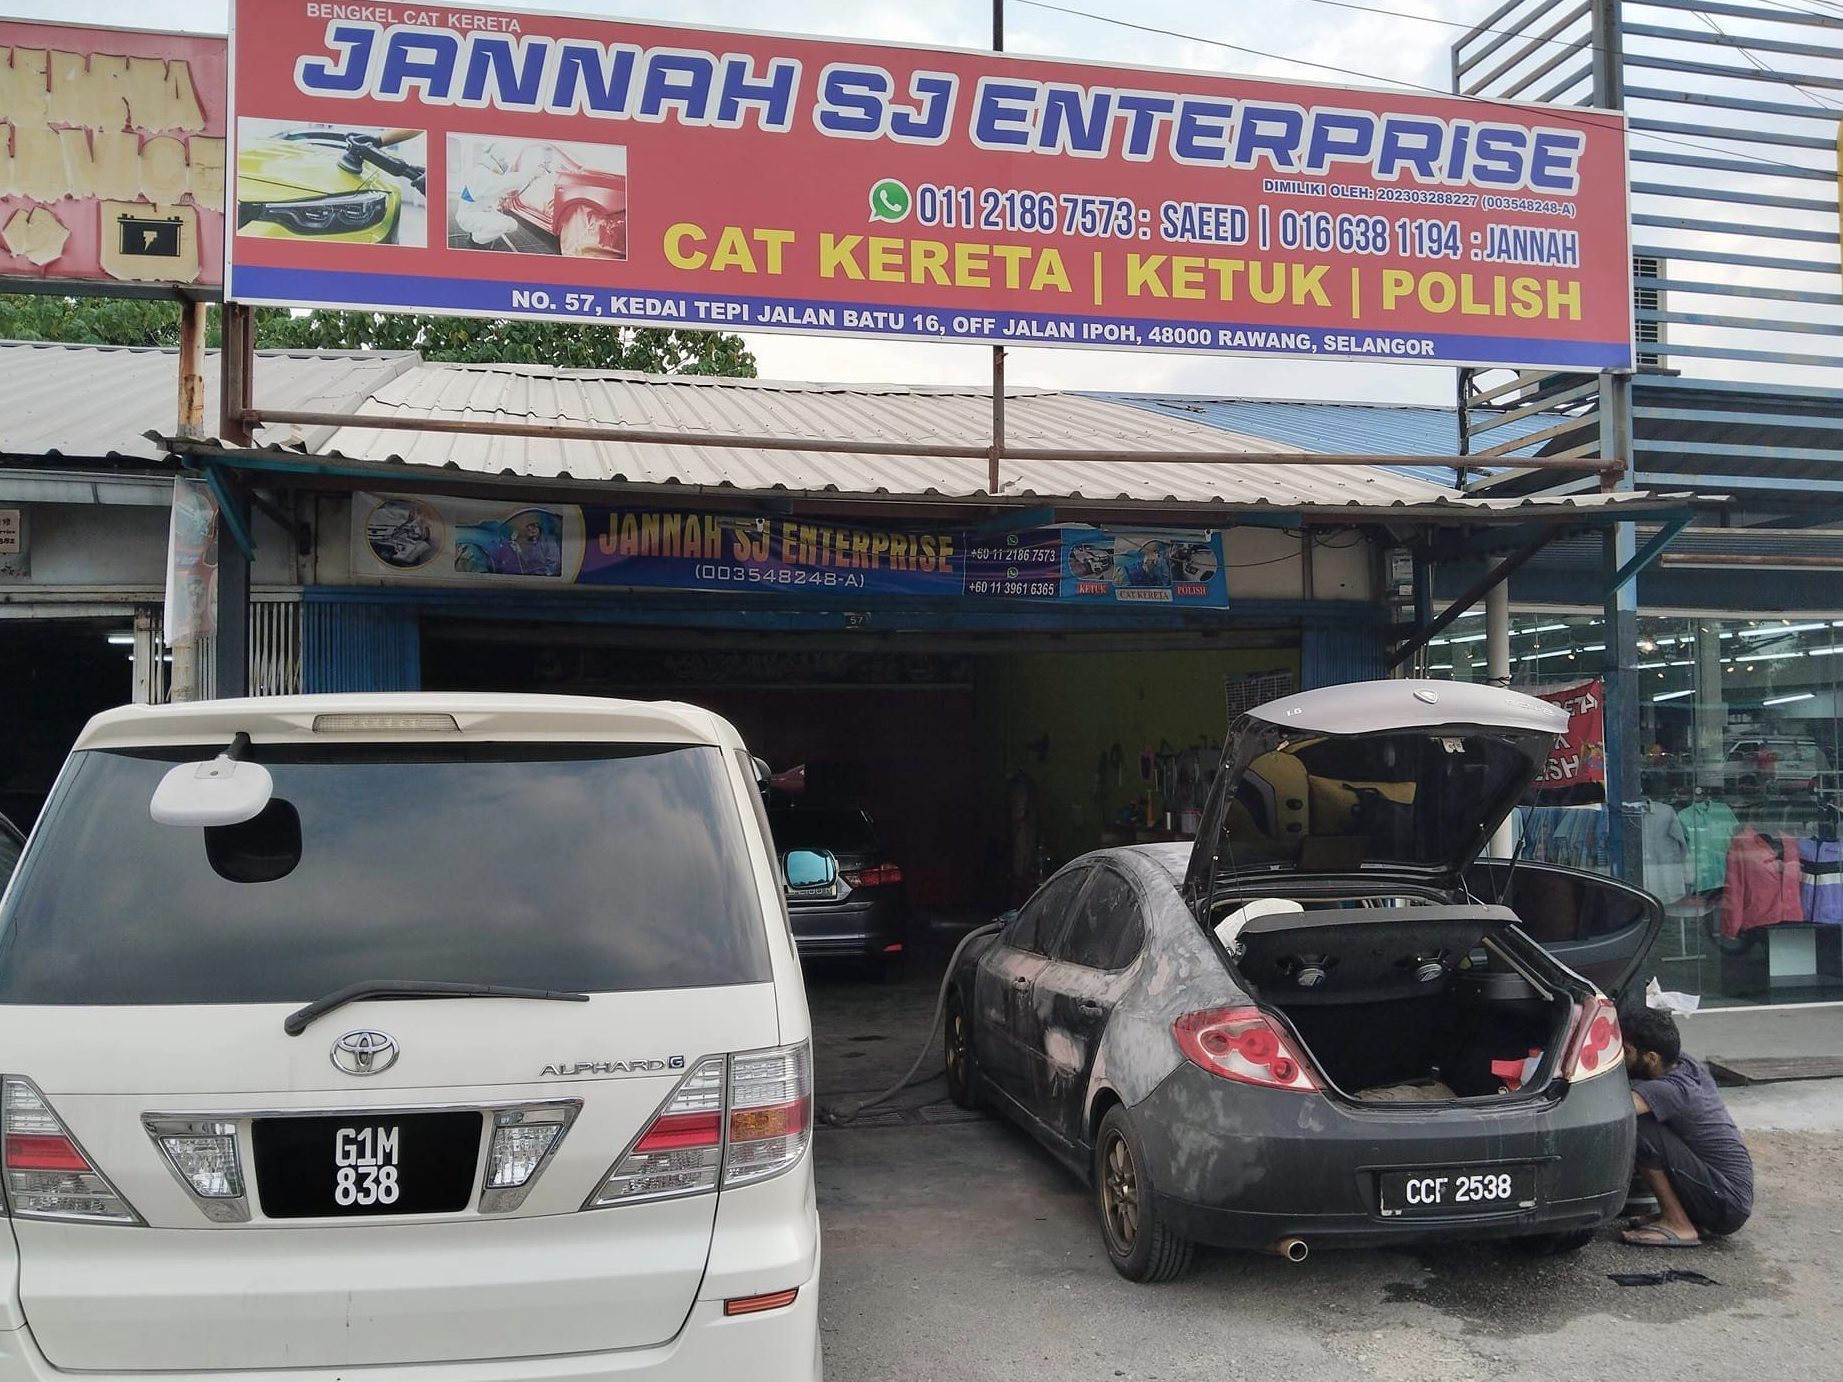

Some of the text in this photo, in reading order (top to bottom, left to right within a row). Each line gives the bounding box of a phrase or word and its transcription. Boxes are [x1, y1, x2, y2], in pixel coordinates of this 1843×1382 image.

[306, 3, 521, 33] BENGKEL CAT KERETA
[295, 20, 1586, 195] JANNAH SJ ENTERPRISE
[1263, 179, 1576, 218] DIMILIKI OLEH: 202303288227 (003548248-A)
[917, 183, 976, 230] 011
[981, 188, 1057, 234] 2186
[1163, 200, 1247, 246] SAEED
[1280, 209, 1332, 253] 016
[1336, 213, 1387, 256] 638
[1397, 216, 1460, 260] 1194
[662, 223, 795, 275] CAT
[819, 233, 1073, 293] KERETA
[1127, 253, 1332, 306] KETUK
[1385, 268, 1582, 321] POLISH
[511, 290, 1435, 357] NO. 57, KEDAI TEPI JALAN BATU 16, OFF JALAN IPOH, 48000 RAWANG, SELANGOR
[599, 512, 954, 573] JANNAH SJ ENTERPRISE
[1006, 549, 1029, 561] 2186
[1032, 550, 1056, 562] 7573
[695, 565, 865, 588] (003548248-A)
[969, 580, 1054, 596] +60 11 3961 6365
[1079, 584, 1107, 594] KETUK
[1177, 586, 1206, 596] POLISH
[539, 1055, 684, 1077] ALPHARD G
[335, 1127, 399, 1167] G1M
[335, 1165, 400, 1206] 838
[1455, 1174, 1512, 1202] 2538
